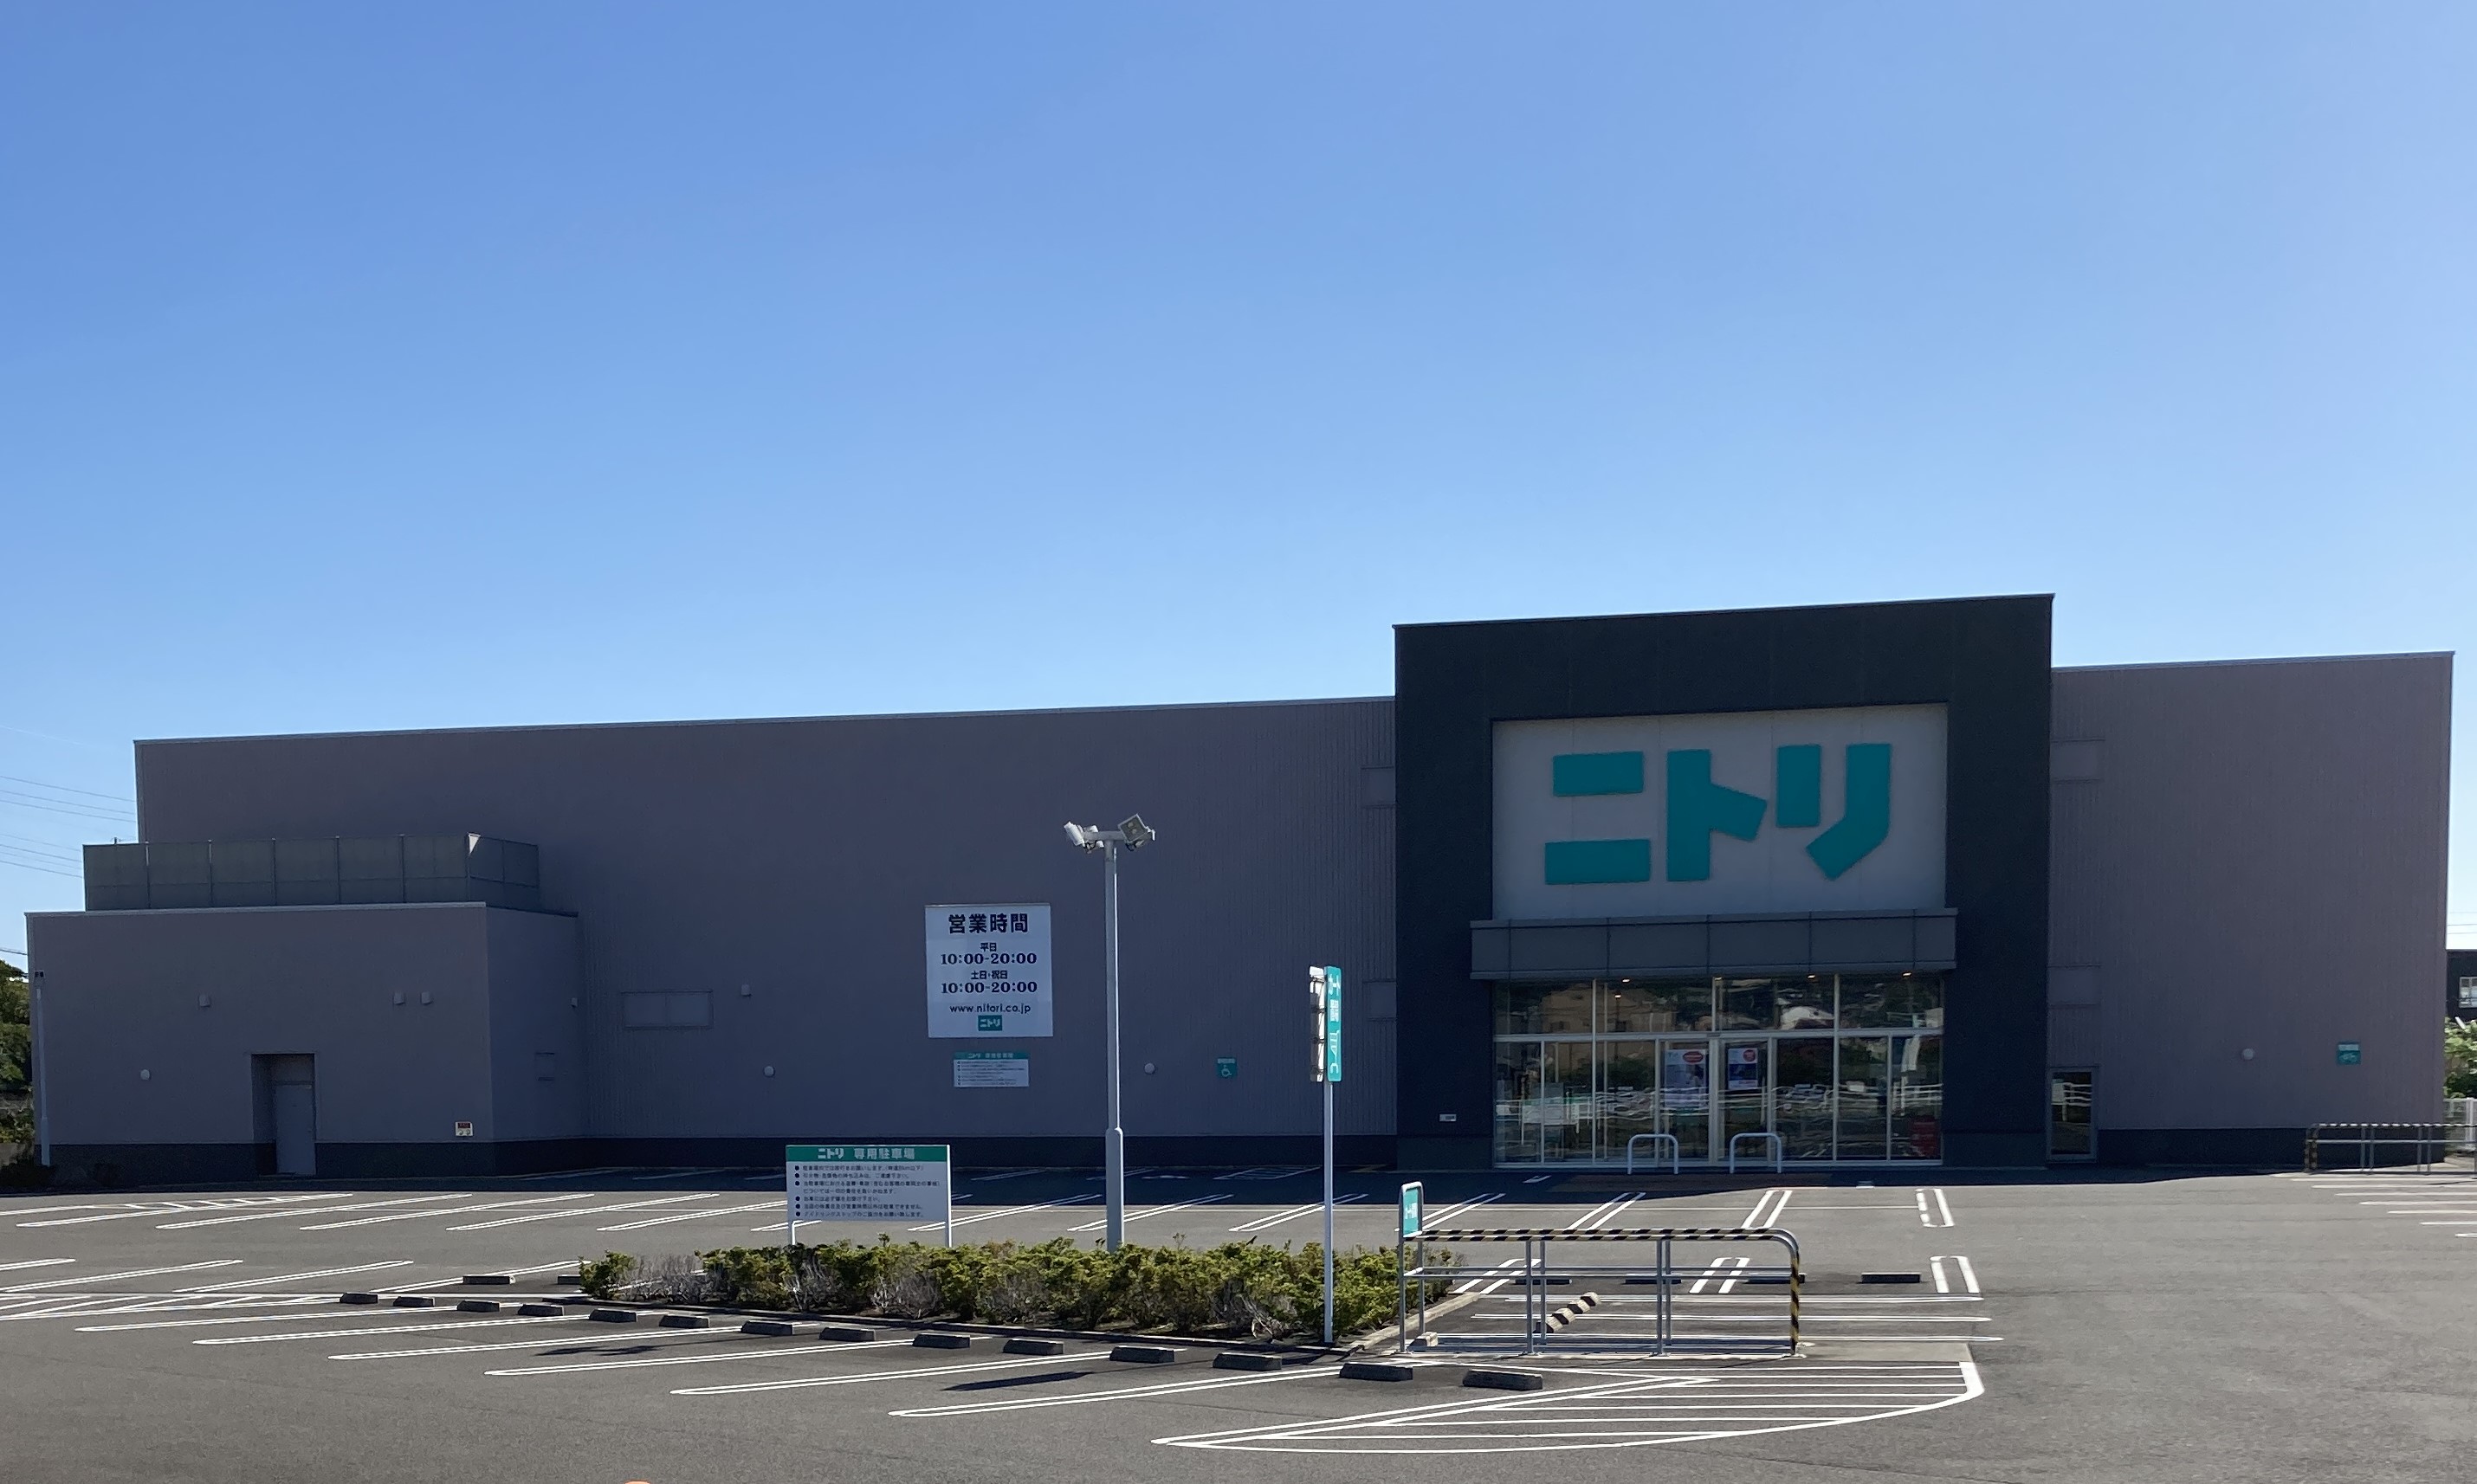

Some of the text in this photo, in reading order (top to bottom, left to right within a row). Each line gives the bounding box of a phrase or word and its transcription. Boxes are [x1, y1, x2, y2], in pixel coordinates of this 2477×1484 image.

[1544, 743, 1892, 885] ニトリ
[947, 913, 1028, 934] 営業時間
[980, 942, 997, 952] 平日
[949, 1003, 1031, 1015] www.nitori.co.jp
[980, 1018, 1000, 1029] ニトリ
[818, 1147, 844, 1159] ニトリ
